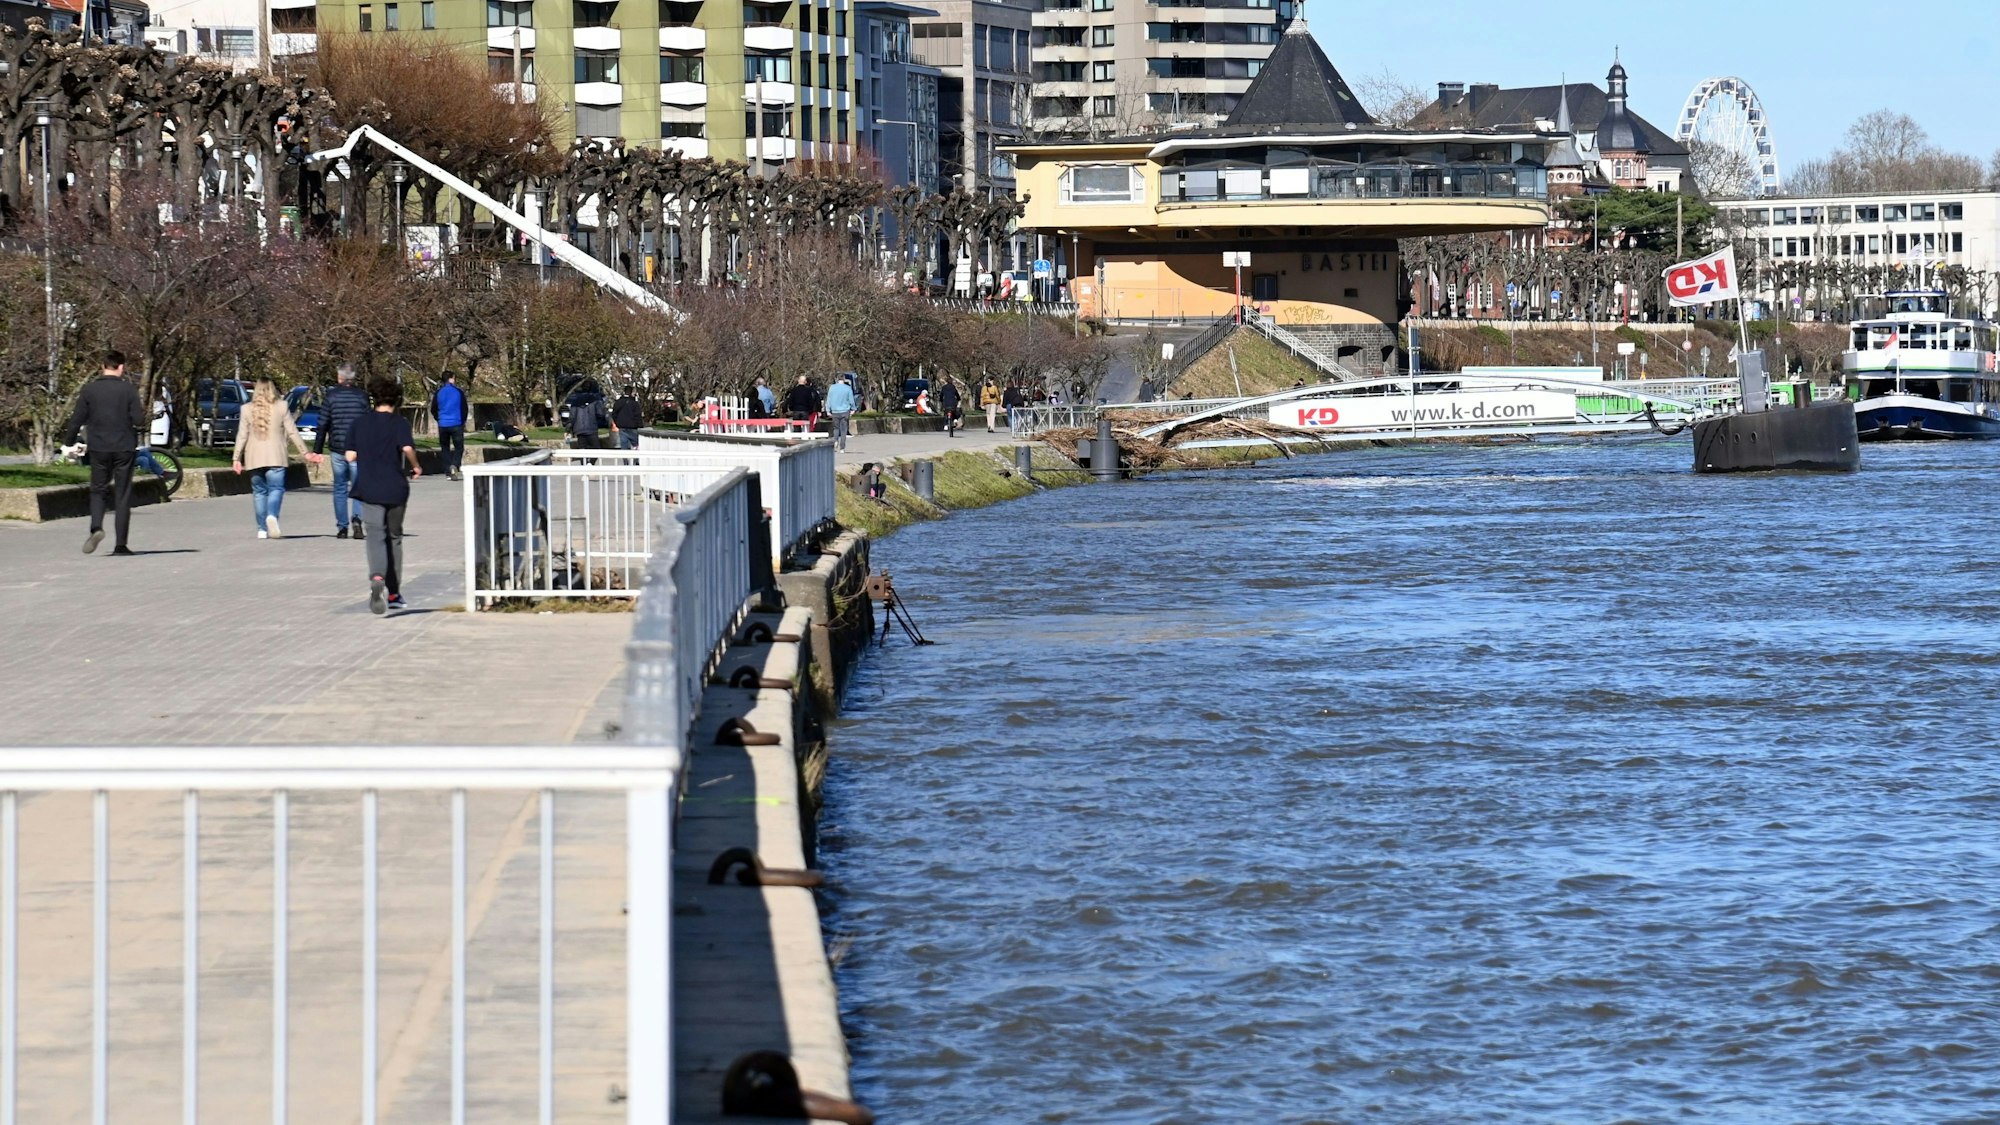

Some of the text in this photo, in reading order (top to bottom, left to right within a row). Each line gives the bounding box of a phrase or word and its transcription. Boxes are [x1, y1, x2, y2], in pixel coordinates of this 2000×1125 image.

[1302, 253, 1387, 271] BASTEI
[1298, 408, 1339, 426] KD
[1391, 401, 1535, 422] www.k-d.com
